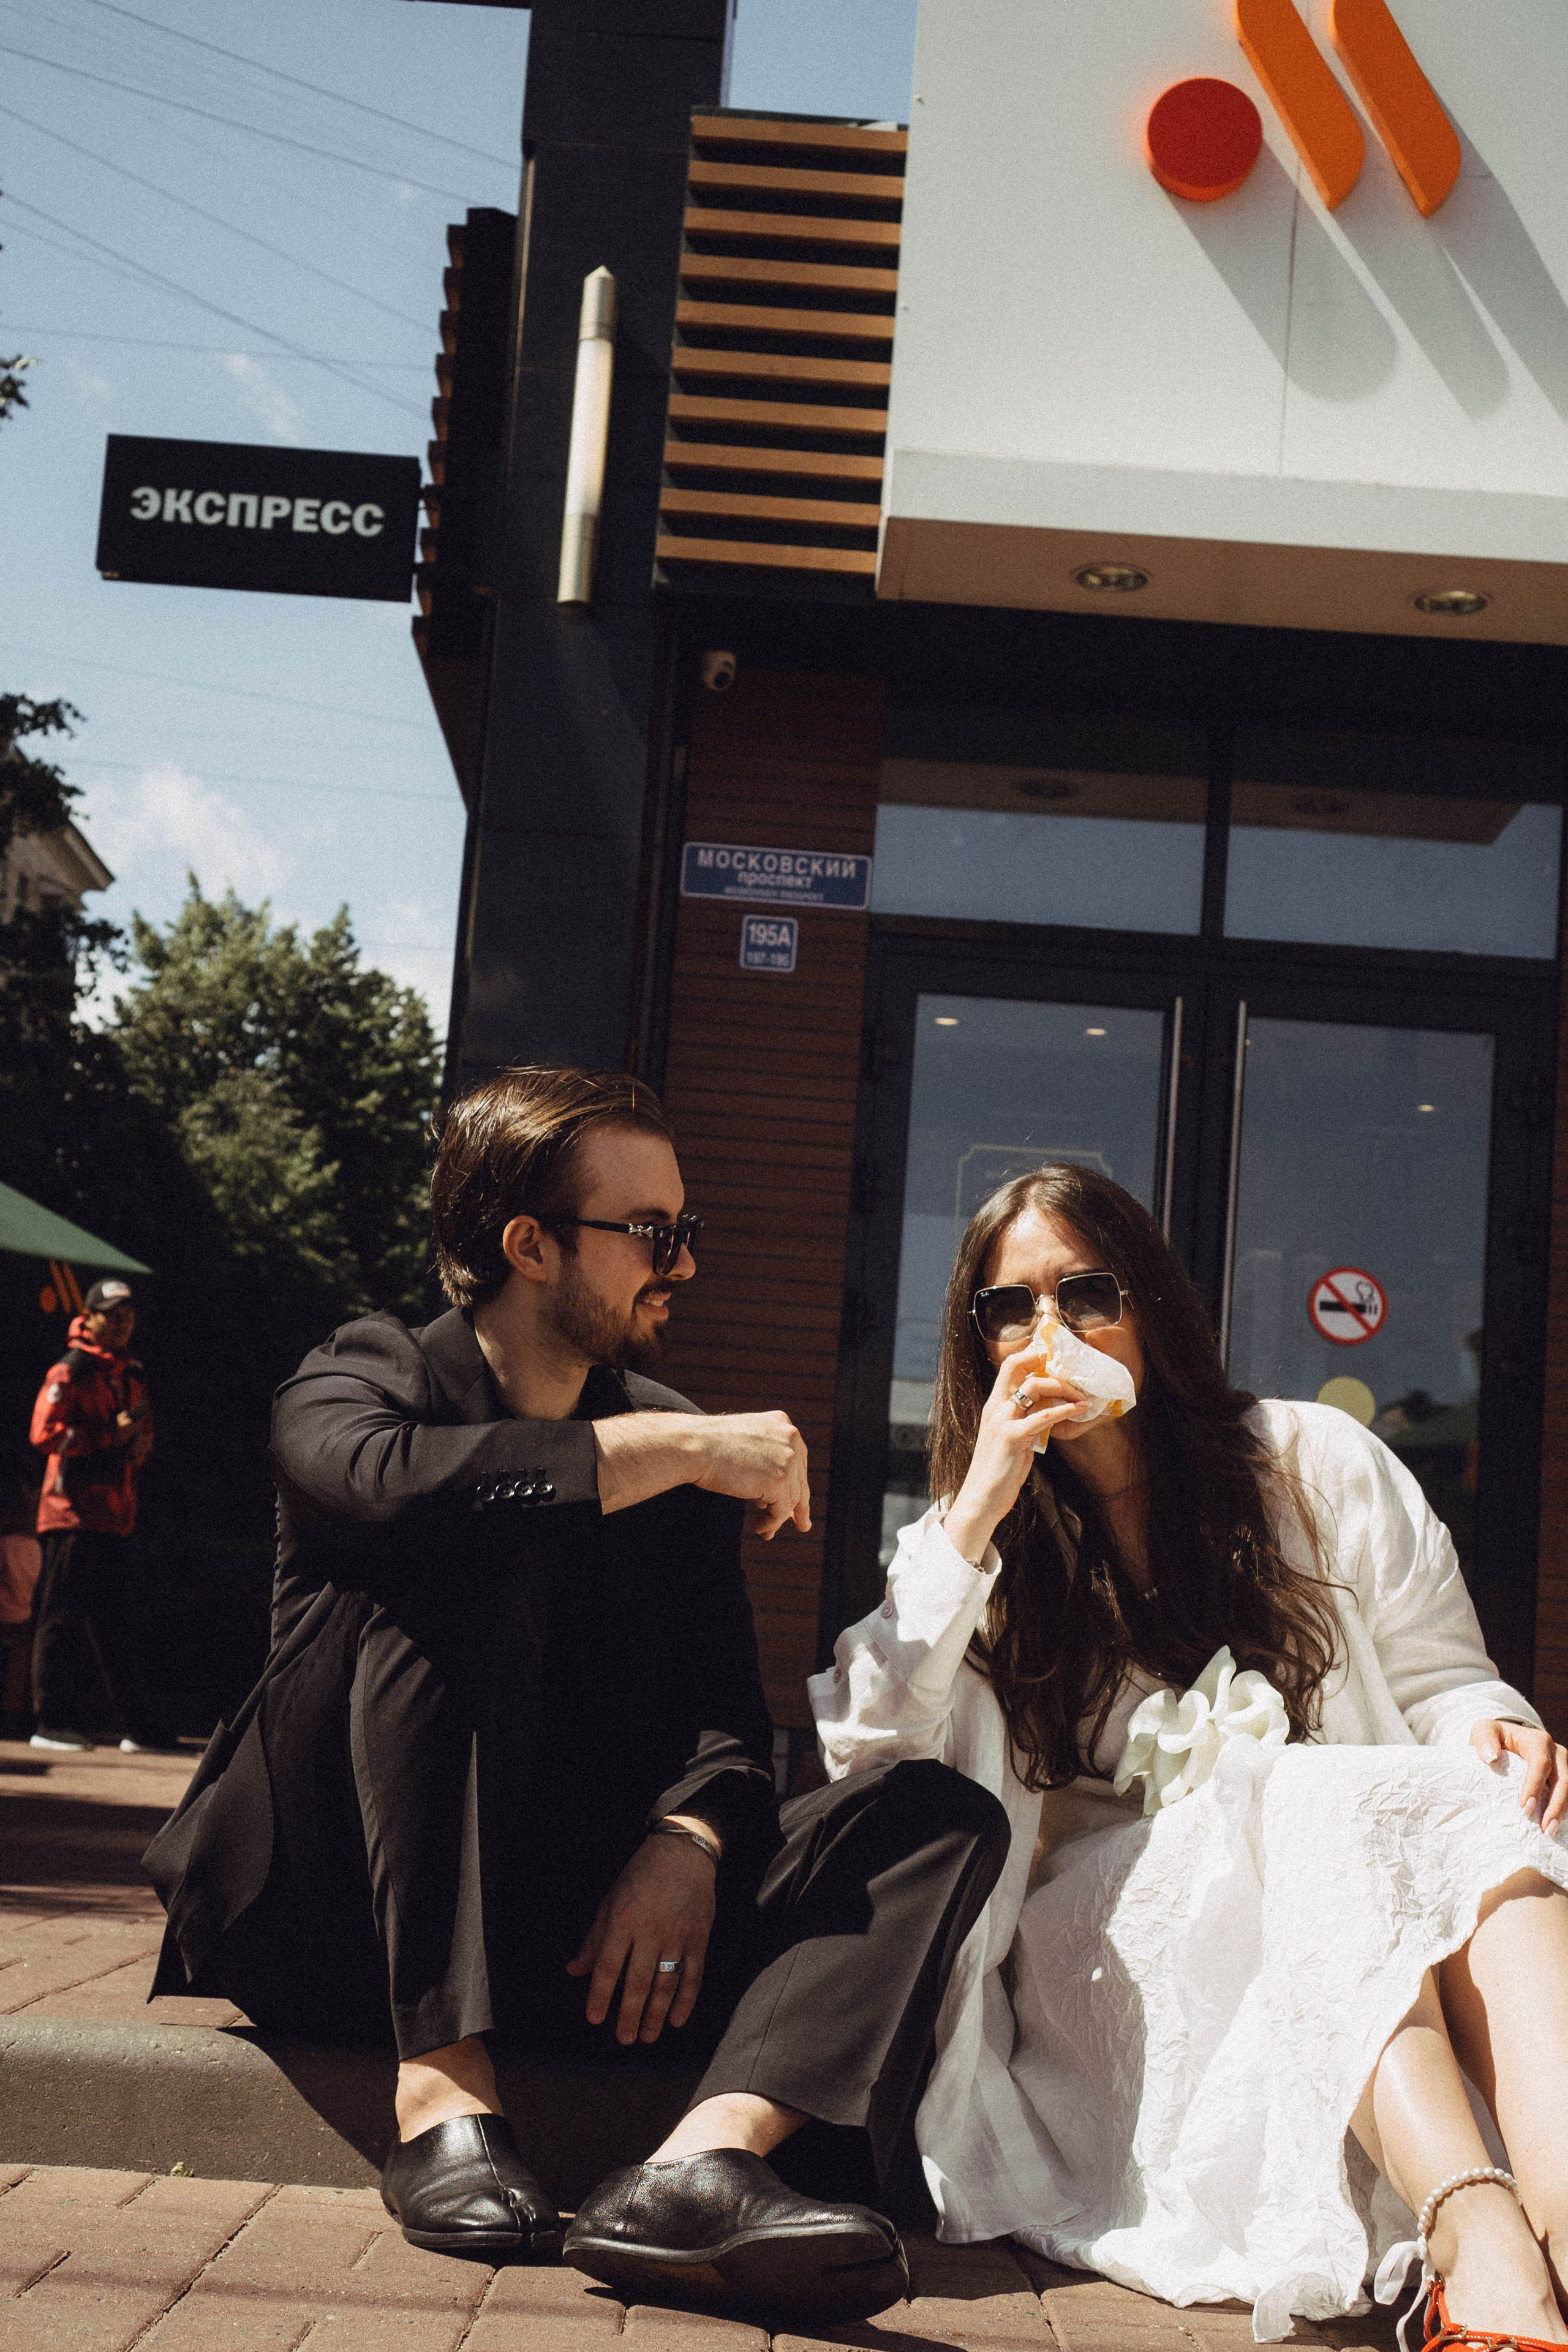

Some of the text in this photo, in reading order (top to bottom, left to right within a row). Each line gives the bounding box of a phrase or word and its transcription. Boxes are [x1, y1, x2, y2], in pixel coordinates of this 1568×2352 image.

[130, 485, 385, 537] ЭКСПРЕСС
[697, 848, 856, 879] МОСКОВСКИЙ
[737, 870, 813, 889] проспект
[748, 922, 792, 946] 195А
